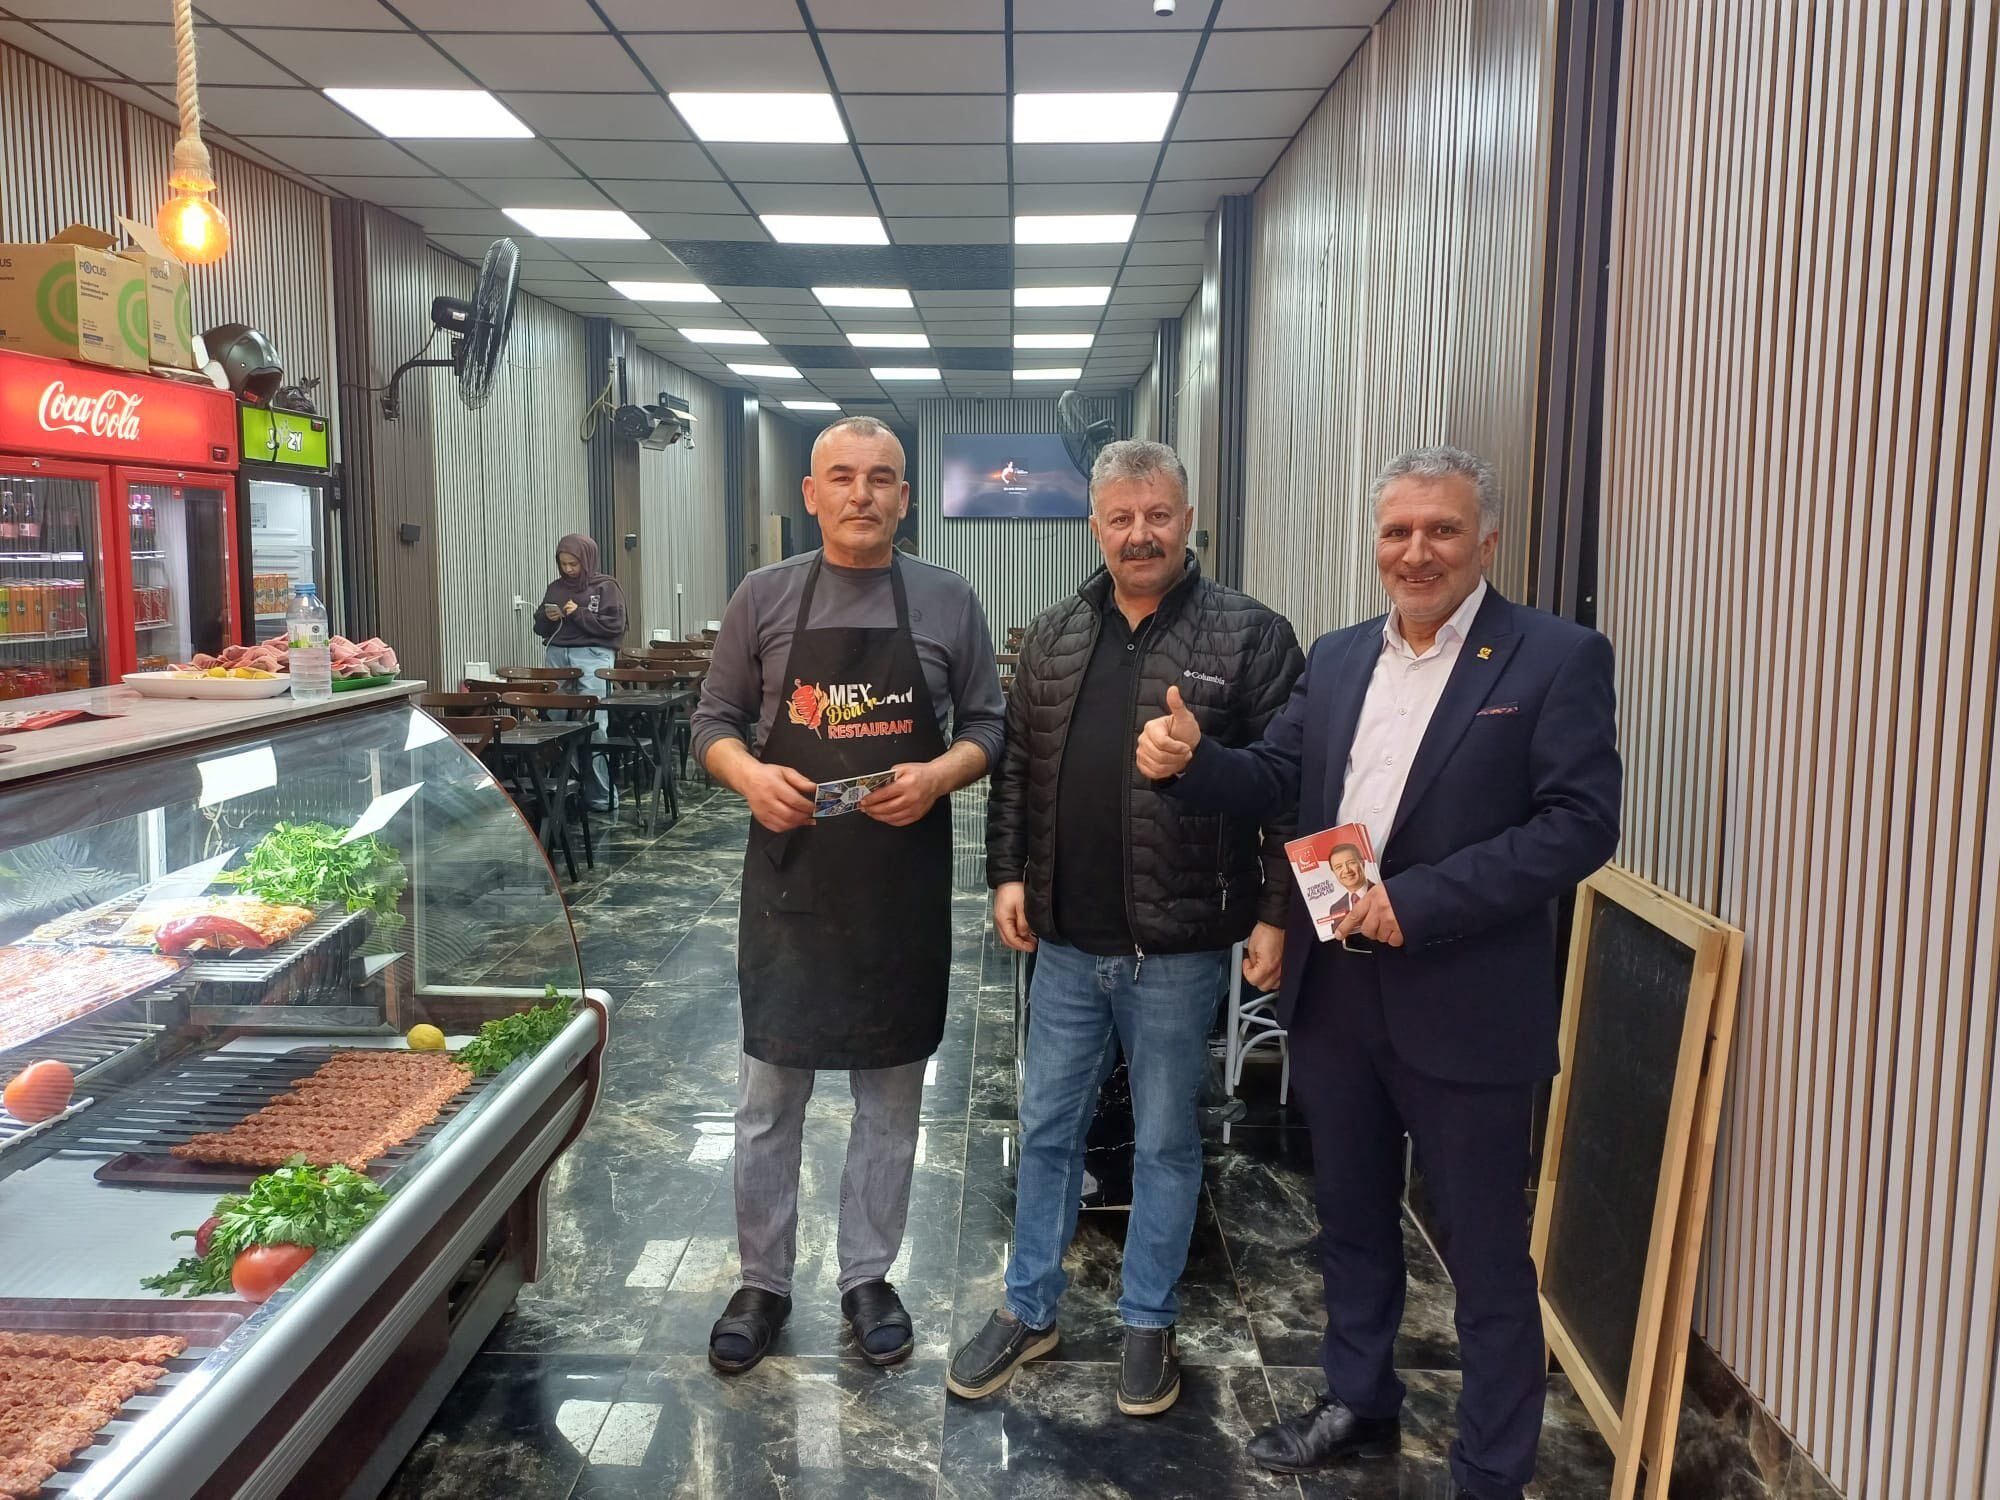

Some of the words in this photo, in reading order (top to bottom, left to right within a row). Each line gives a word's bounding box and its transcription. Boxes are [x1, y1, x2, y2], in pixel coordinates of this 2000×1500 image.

[79, 260, 107, 277] FOCUS
[39, 381, 144, 440] Coca-Cola
[1191, 671, 1225, 685] Columbia
[828, 720, 913, 739] RESTAURANT
